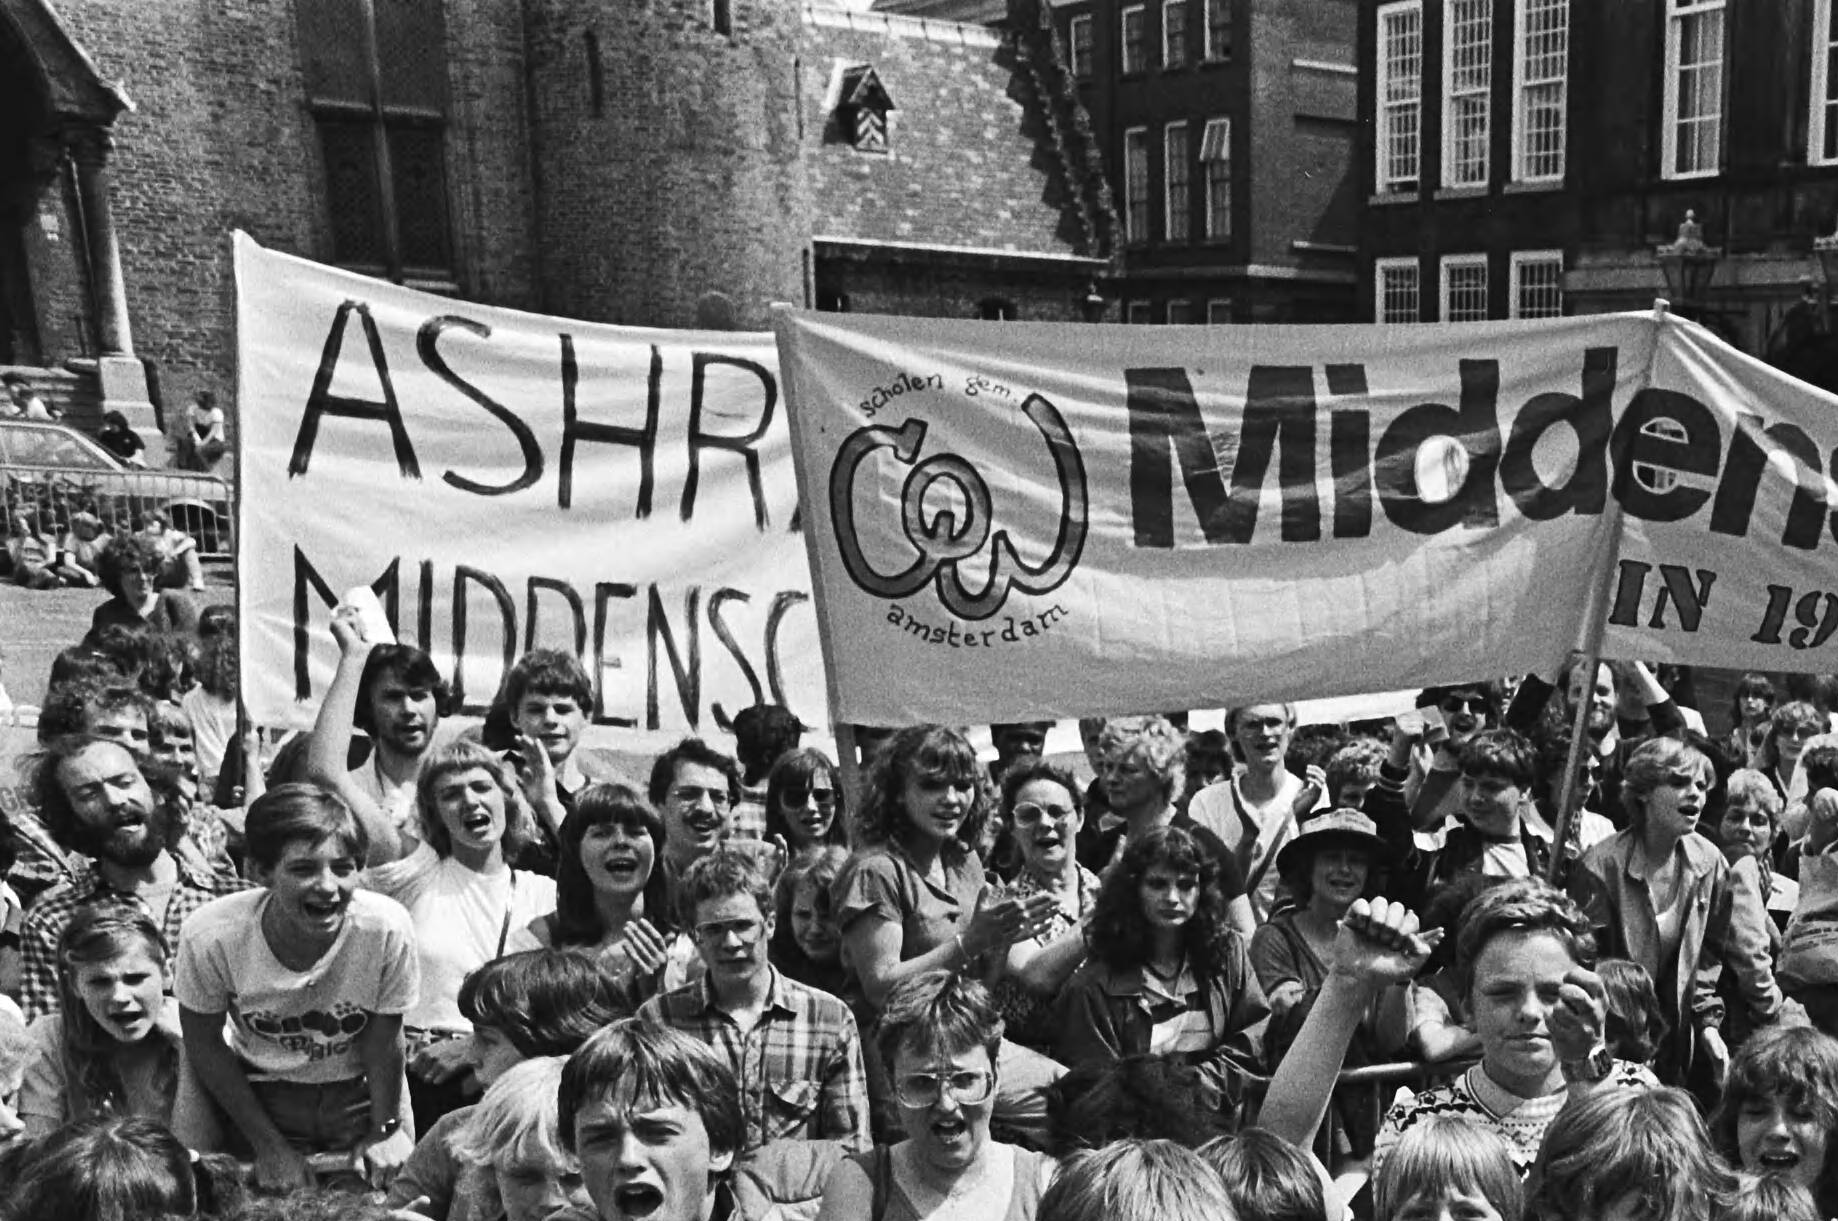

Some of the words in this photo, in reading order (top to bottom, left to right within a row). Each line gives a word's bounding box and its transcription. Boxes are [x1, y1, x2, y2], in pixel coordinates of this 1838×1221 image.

[288, 300, 802, 532] ASHR
[859, 373, 943, 417] scholen
[1608, 559, 1717, 633] IN
[886, 604, 1069, 648] amsterdam
